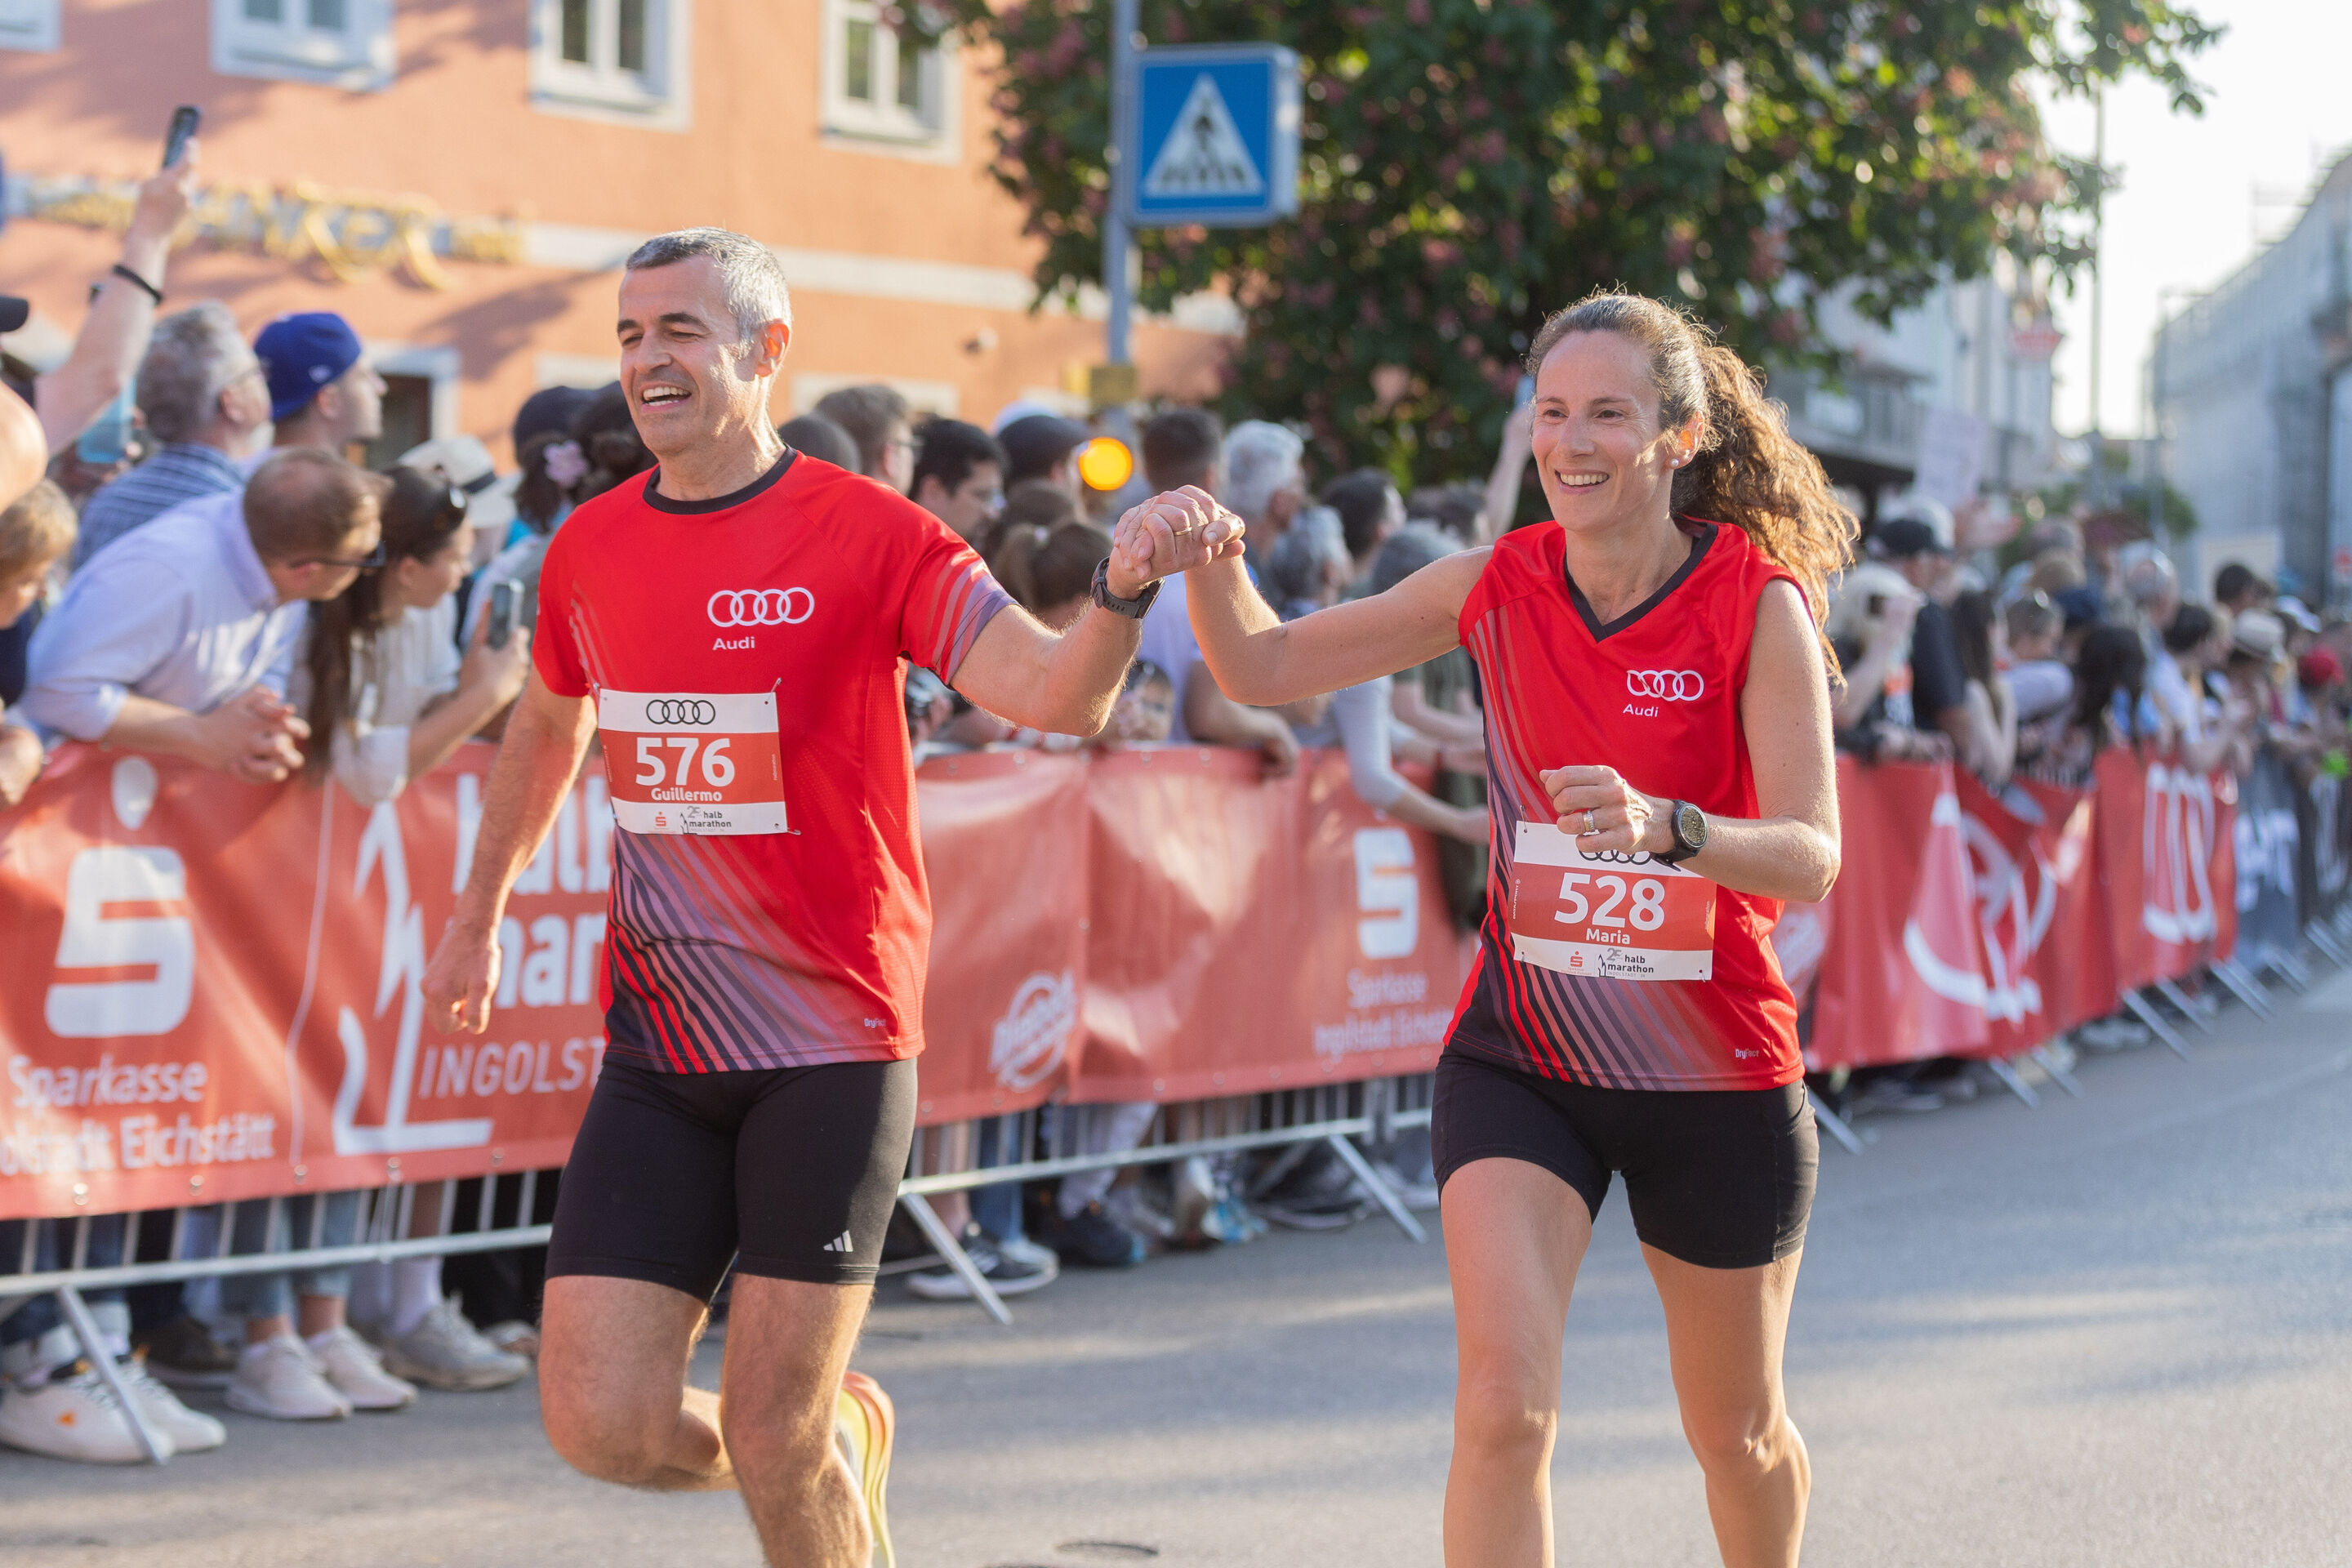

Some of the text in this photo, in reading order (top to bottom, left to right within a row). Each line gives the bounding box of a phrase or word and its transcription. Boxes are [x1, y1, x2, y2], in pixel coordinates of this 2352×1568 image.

[712, 636, 755, 650] Audi
[1623, 703, 1659, 717] Audi
[635, 737, 735, 787] 576
[651, 787, 723, 801] Guillermo
[703, 810, 723, 819] halb
[688, 819, 732, 828] marathon
[1554, 872, 1666, 931] 528
[1586, 928, 1631, 945] Maria
[1624, 954, 1646, 964] halb
[1607, 963, 1655, 973] marathon
[7, 1054, 207, 1118] Sparkasse
